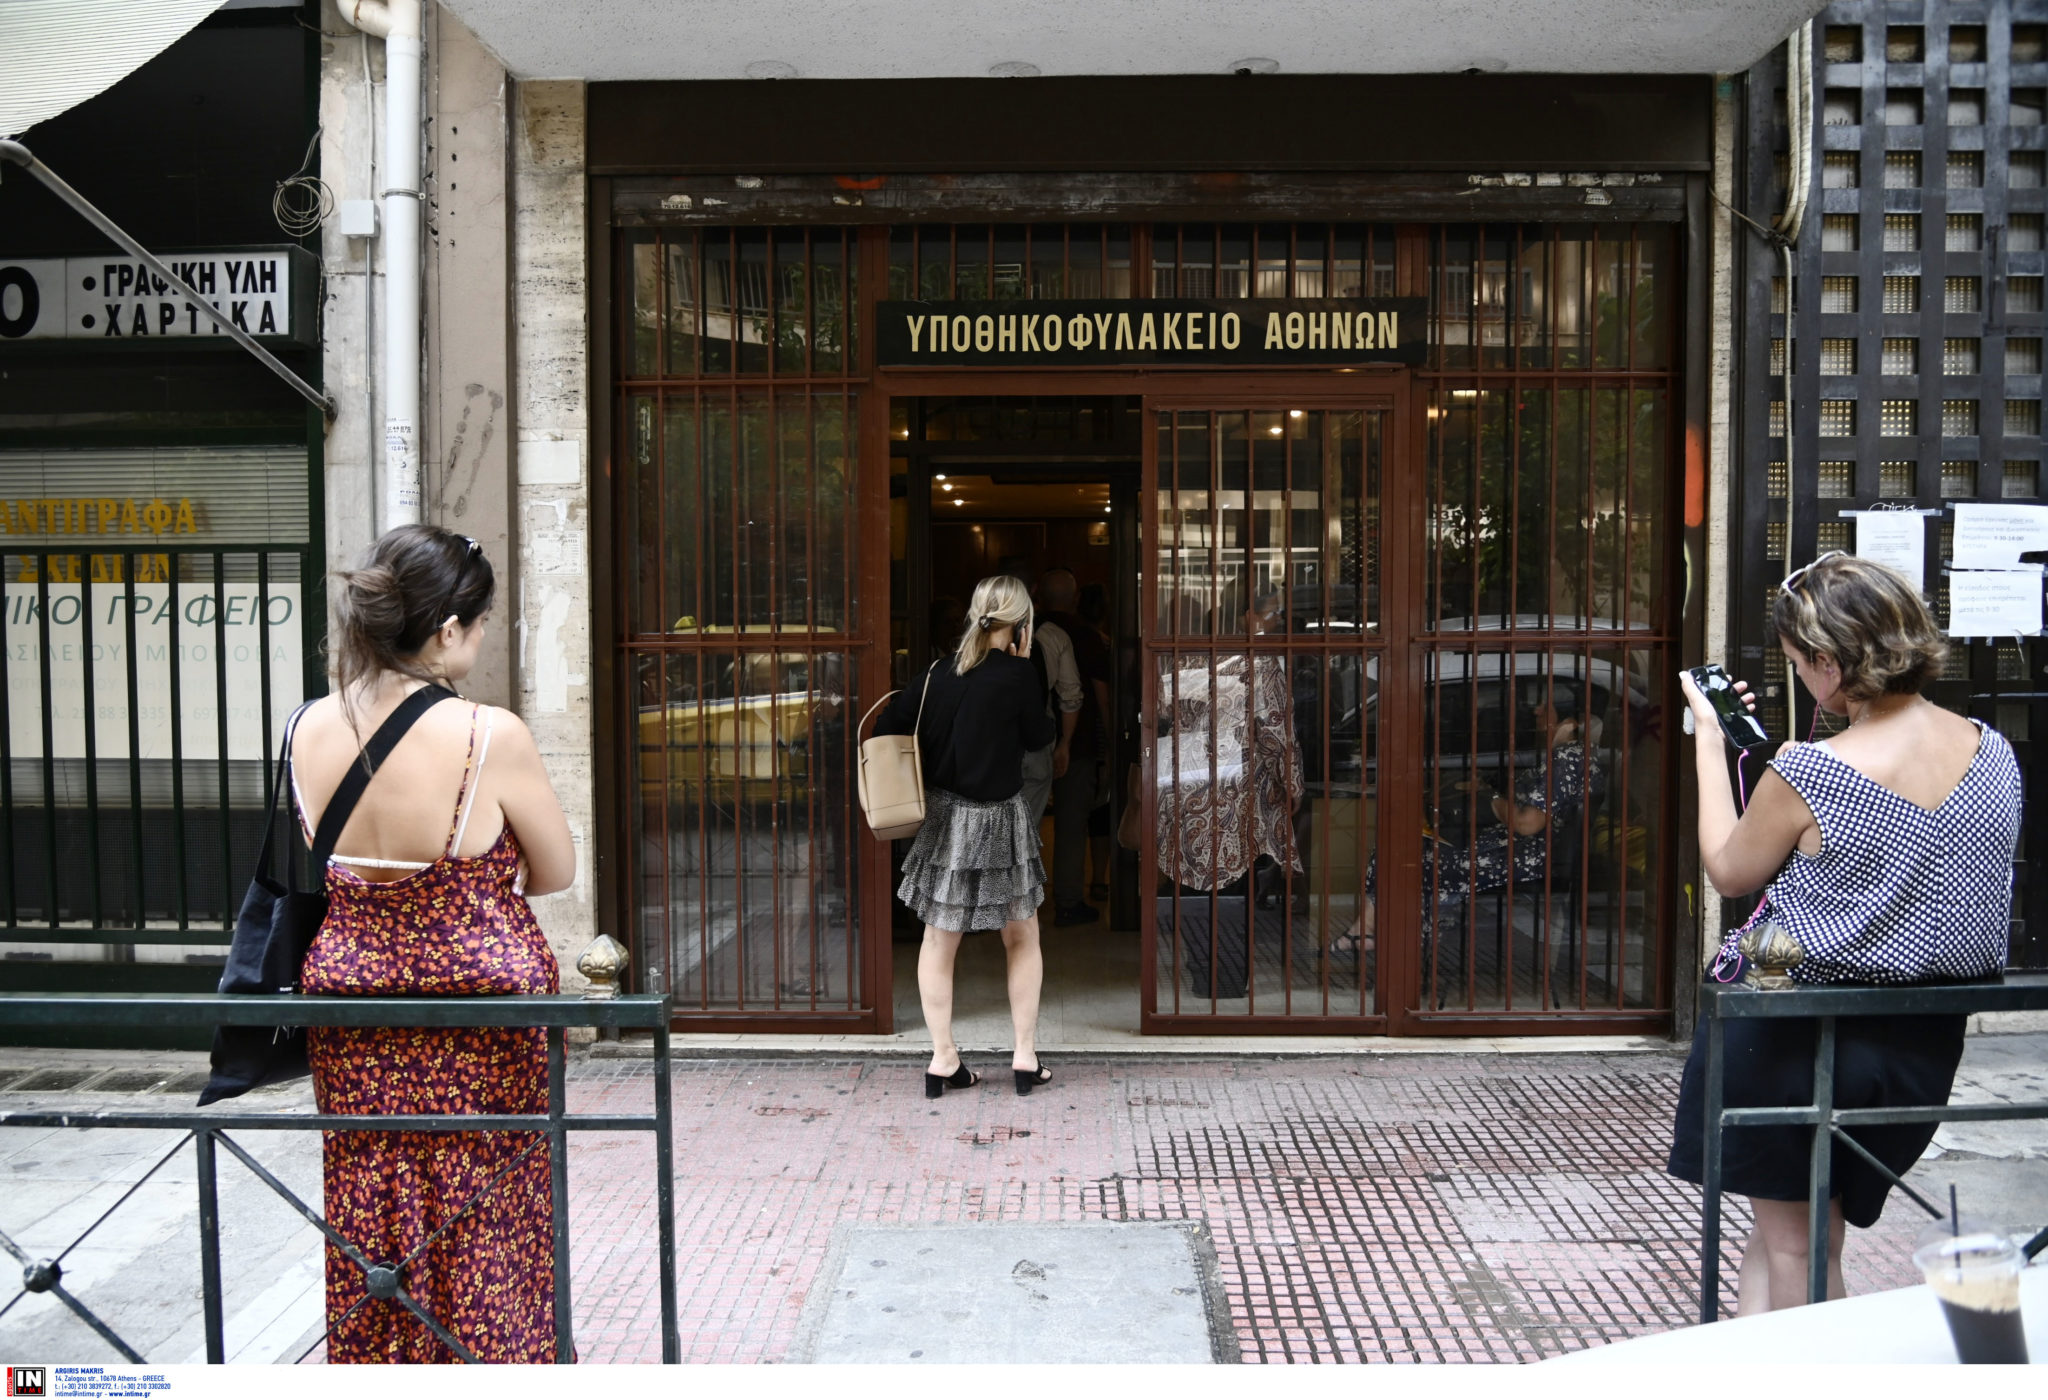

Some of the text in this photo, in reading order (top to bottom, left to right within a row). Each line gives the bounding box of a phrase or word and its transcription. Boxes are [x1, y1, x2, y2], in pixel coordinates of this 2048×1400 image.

[104, 260, 277, 297] ΓΡΑΦΙΚΗ ΥΛΗ
[105, 300, 277, 337] ΧΑΡΤΙΚΑ
[906, 311, 1399, 353] ΥΠΟΘΗΚΟΦΥΛΑΚΕΙΟ ΑΘΗΝΩΝ
[0, 497, 199, 535] ΑΝΤΙΓΡΑΦΑ
[107, 594, 293, 628] ΓΡΑΦΕΙΟ
